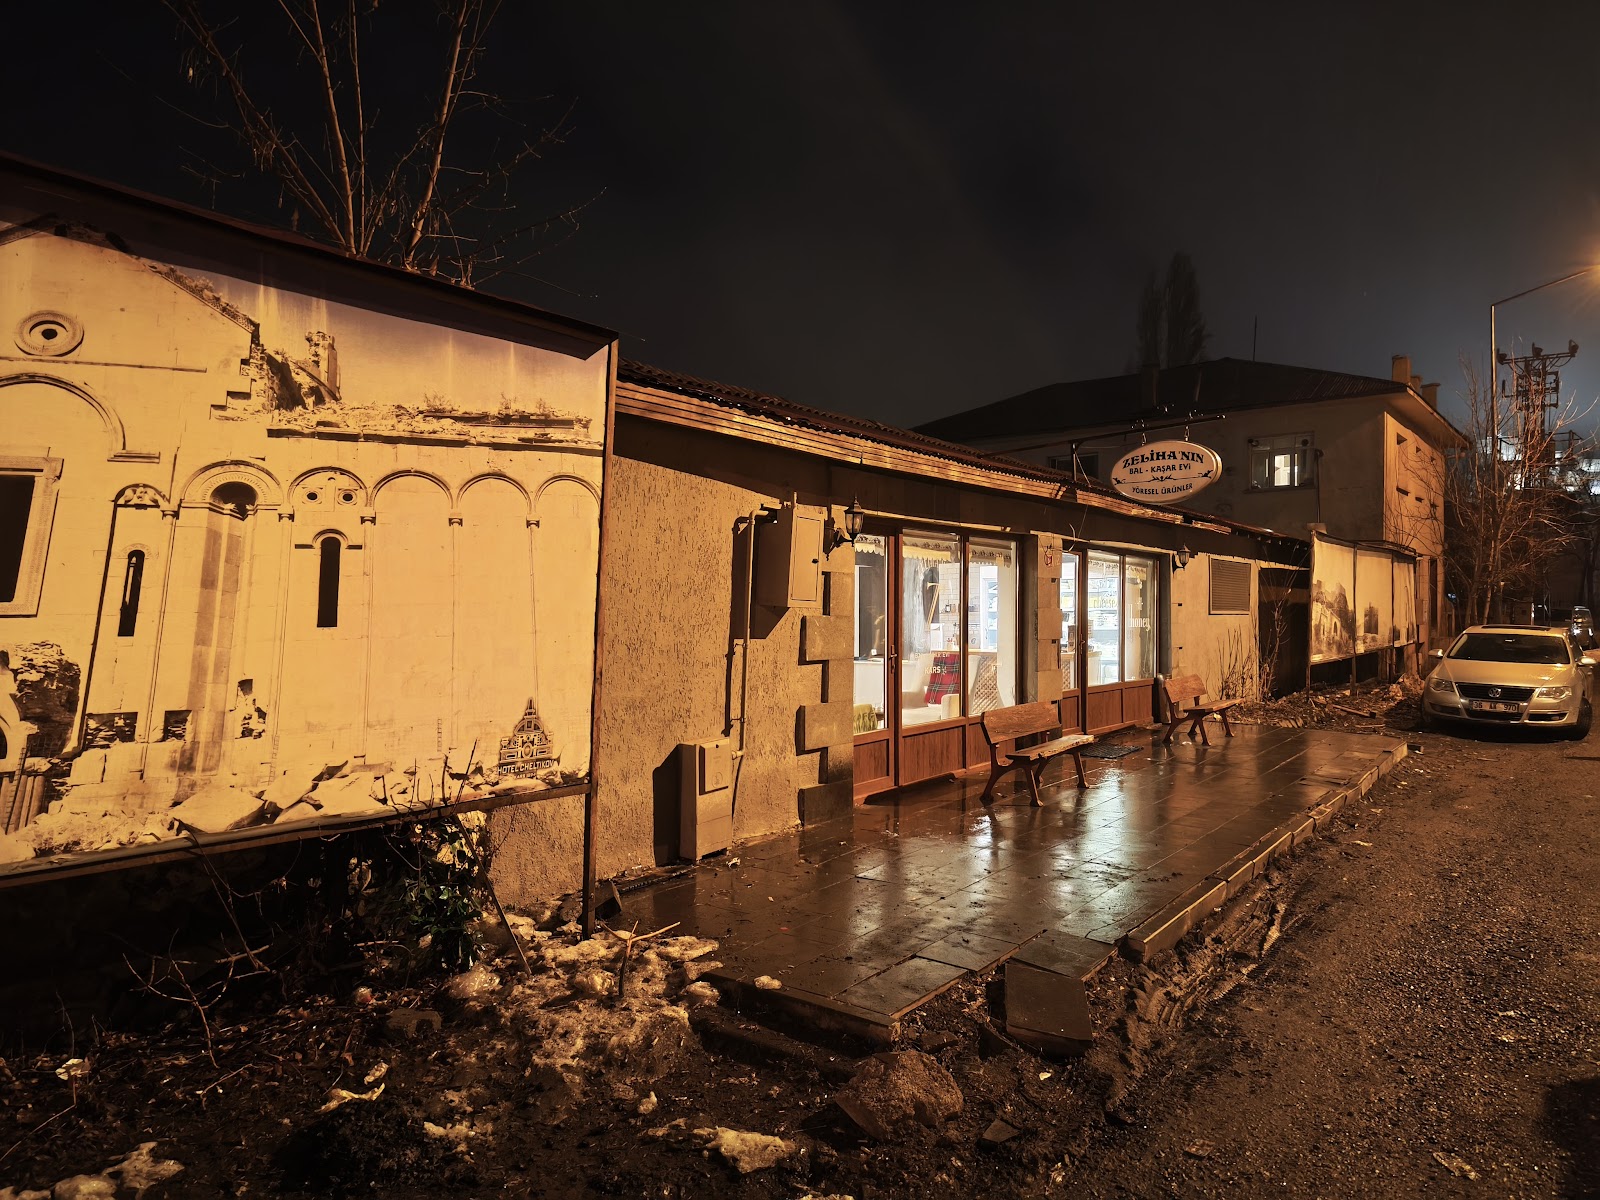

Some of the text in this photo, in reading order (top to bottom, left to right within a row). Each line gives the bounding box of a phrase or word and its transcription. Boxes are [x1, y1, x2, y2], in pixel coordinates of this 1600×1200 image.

[1122, 449, 1205, 469] ZELİHA'NIN
[1129, 467, 1143, 475] BAL
[1150, 465, 1177, 474] KAŞAR
[1131, 482, 1193, 495] YÖRESEL ÜRÜNLER
[1129, 603, 1151, 632] honey
[497, 764, 519, 775] HOTEL
[520, 760, 554, 772] CHELTIKOV
